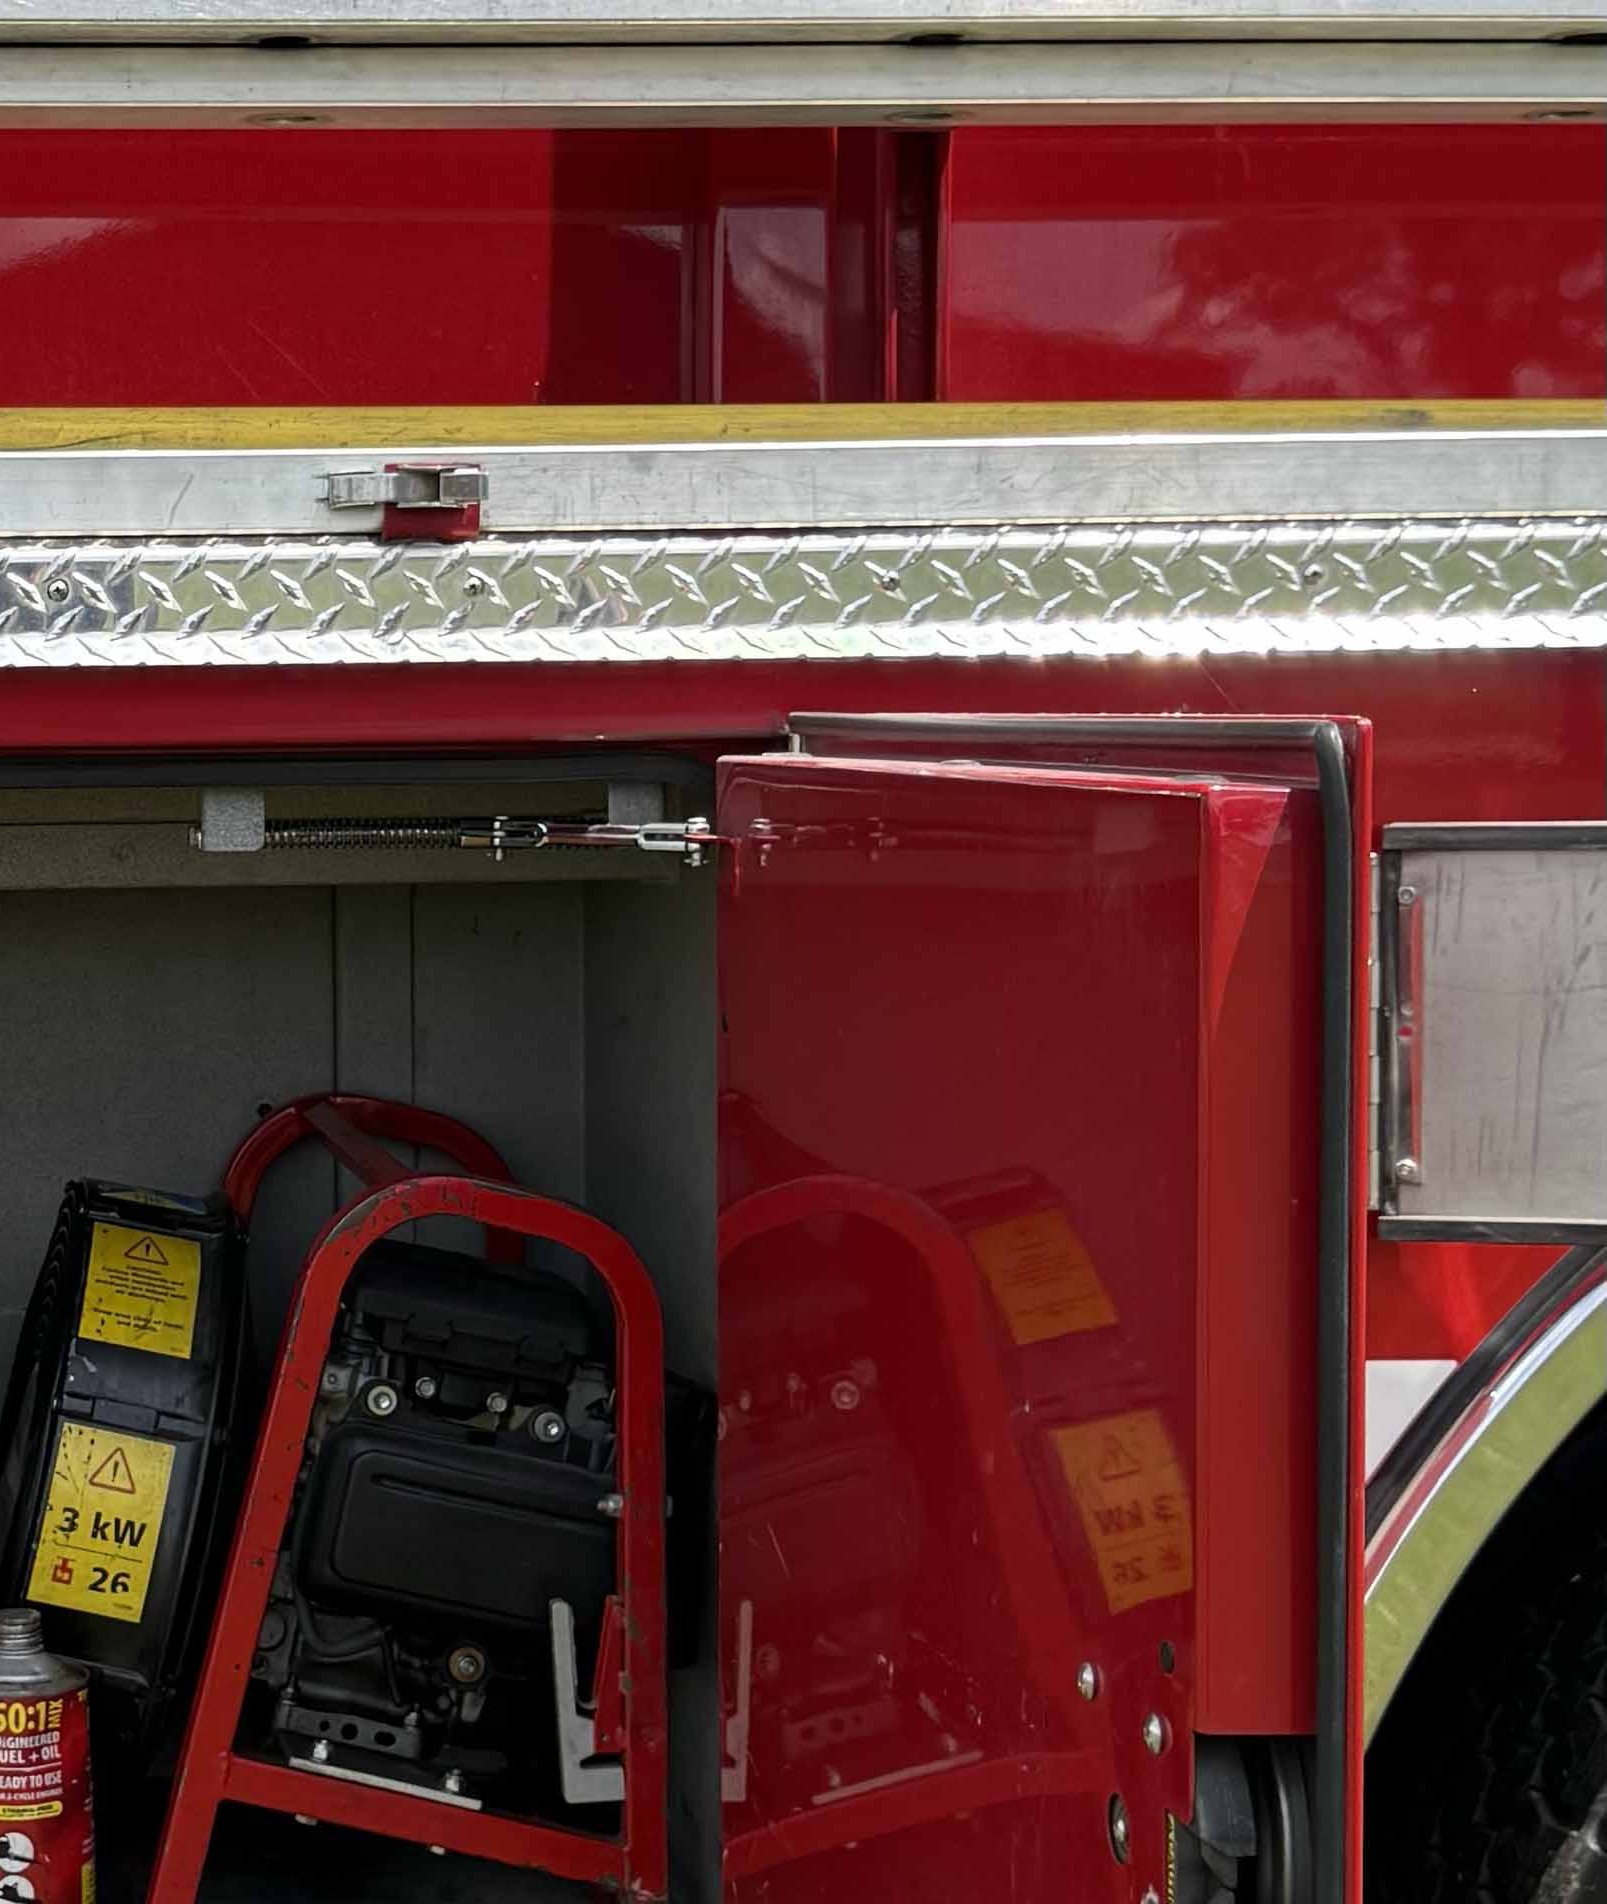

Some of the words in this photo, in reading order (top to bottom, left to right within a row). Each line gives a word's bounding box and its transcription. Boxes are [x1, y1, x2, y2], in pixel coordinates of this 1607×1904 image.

[57, 1507, 80, 1534] 3
[90, 1512, 147, 1547] kW
[88, 1567, 131, 1593] 26
[48, 1698, 64, 1729] MIX
[41, 1744, 62, 1760] OIL
[29, 1774, 43, 1788] TO
[44, 1770, 63, 1786] USE
